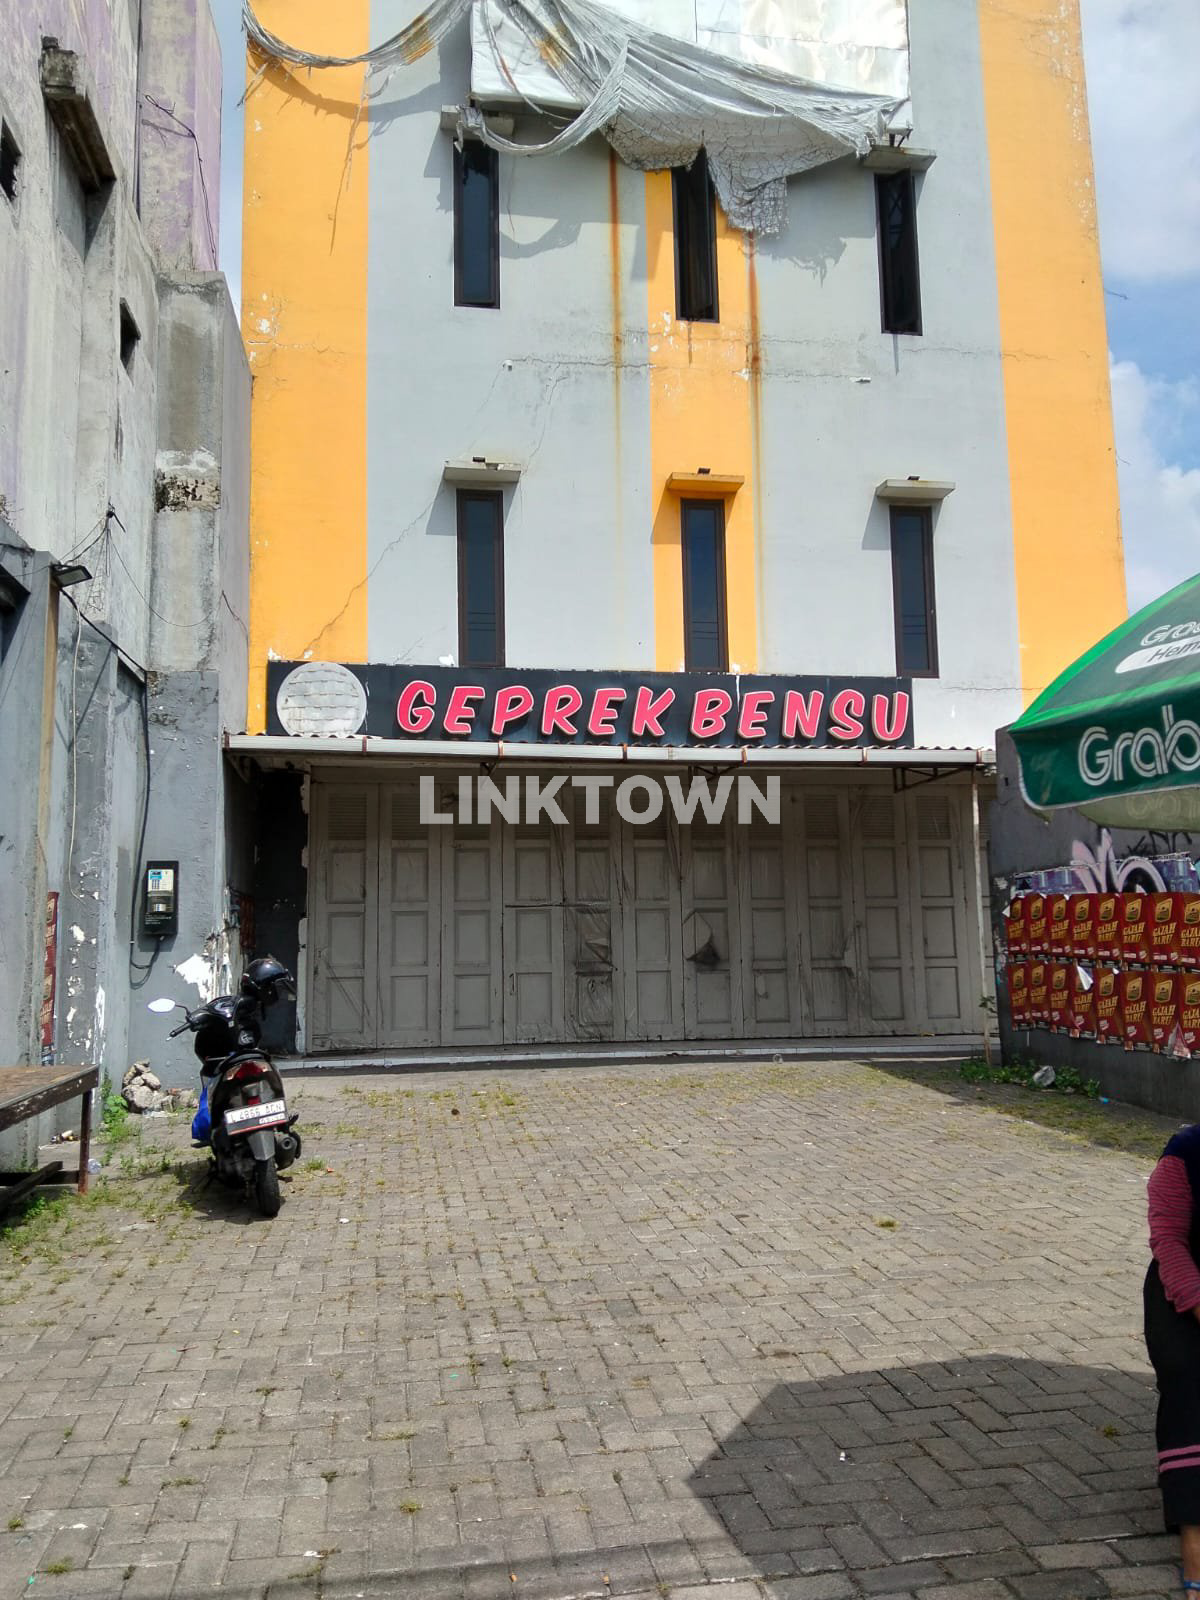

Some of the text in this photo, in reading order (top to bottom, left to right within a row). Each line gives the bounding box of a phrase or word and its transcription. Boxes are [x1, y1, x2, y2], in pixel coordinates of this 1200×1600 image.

[1147, 641, 1200, 663] Hem
[397, 680, 909, 741] GEPREK BENSU
[1078, 704, 1200, 786] Grab
